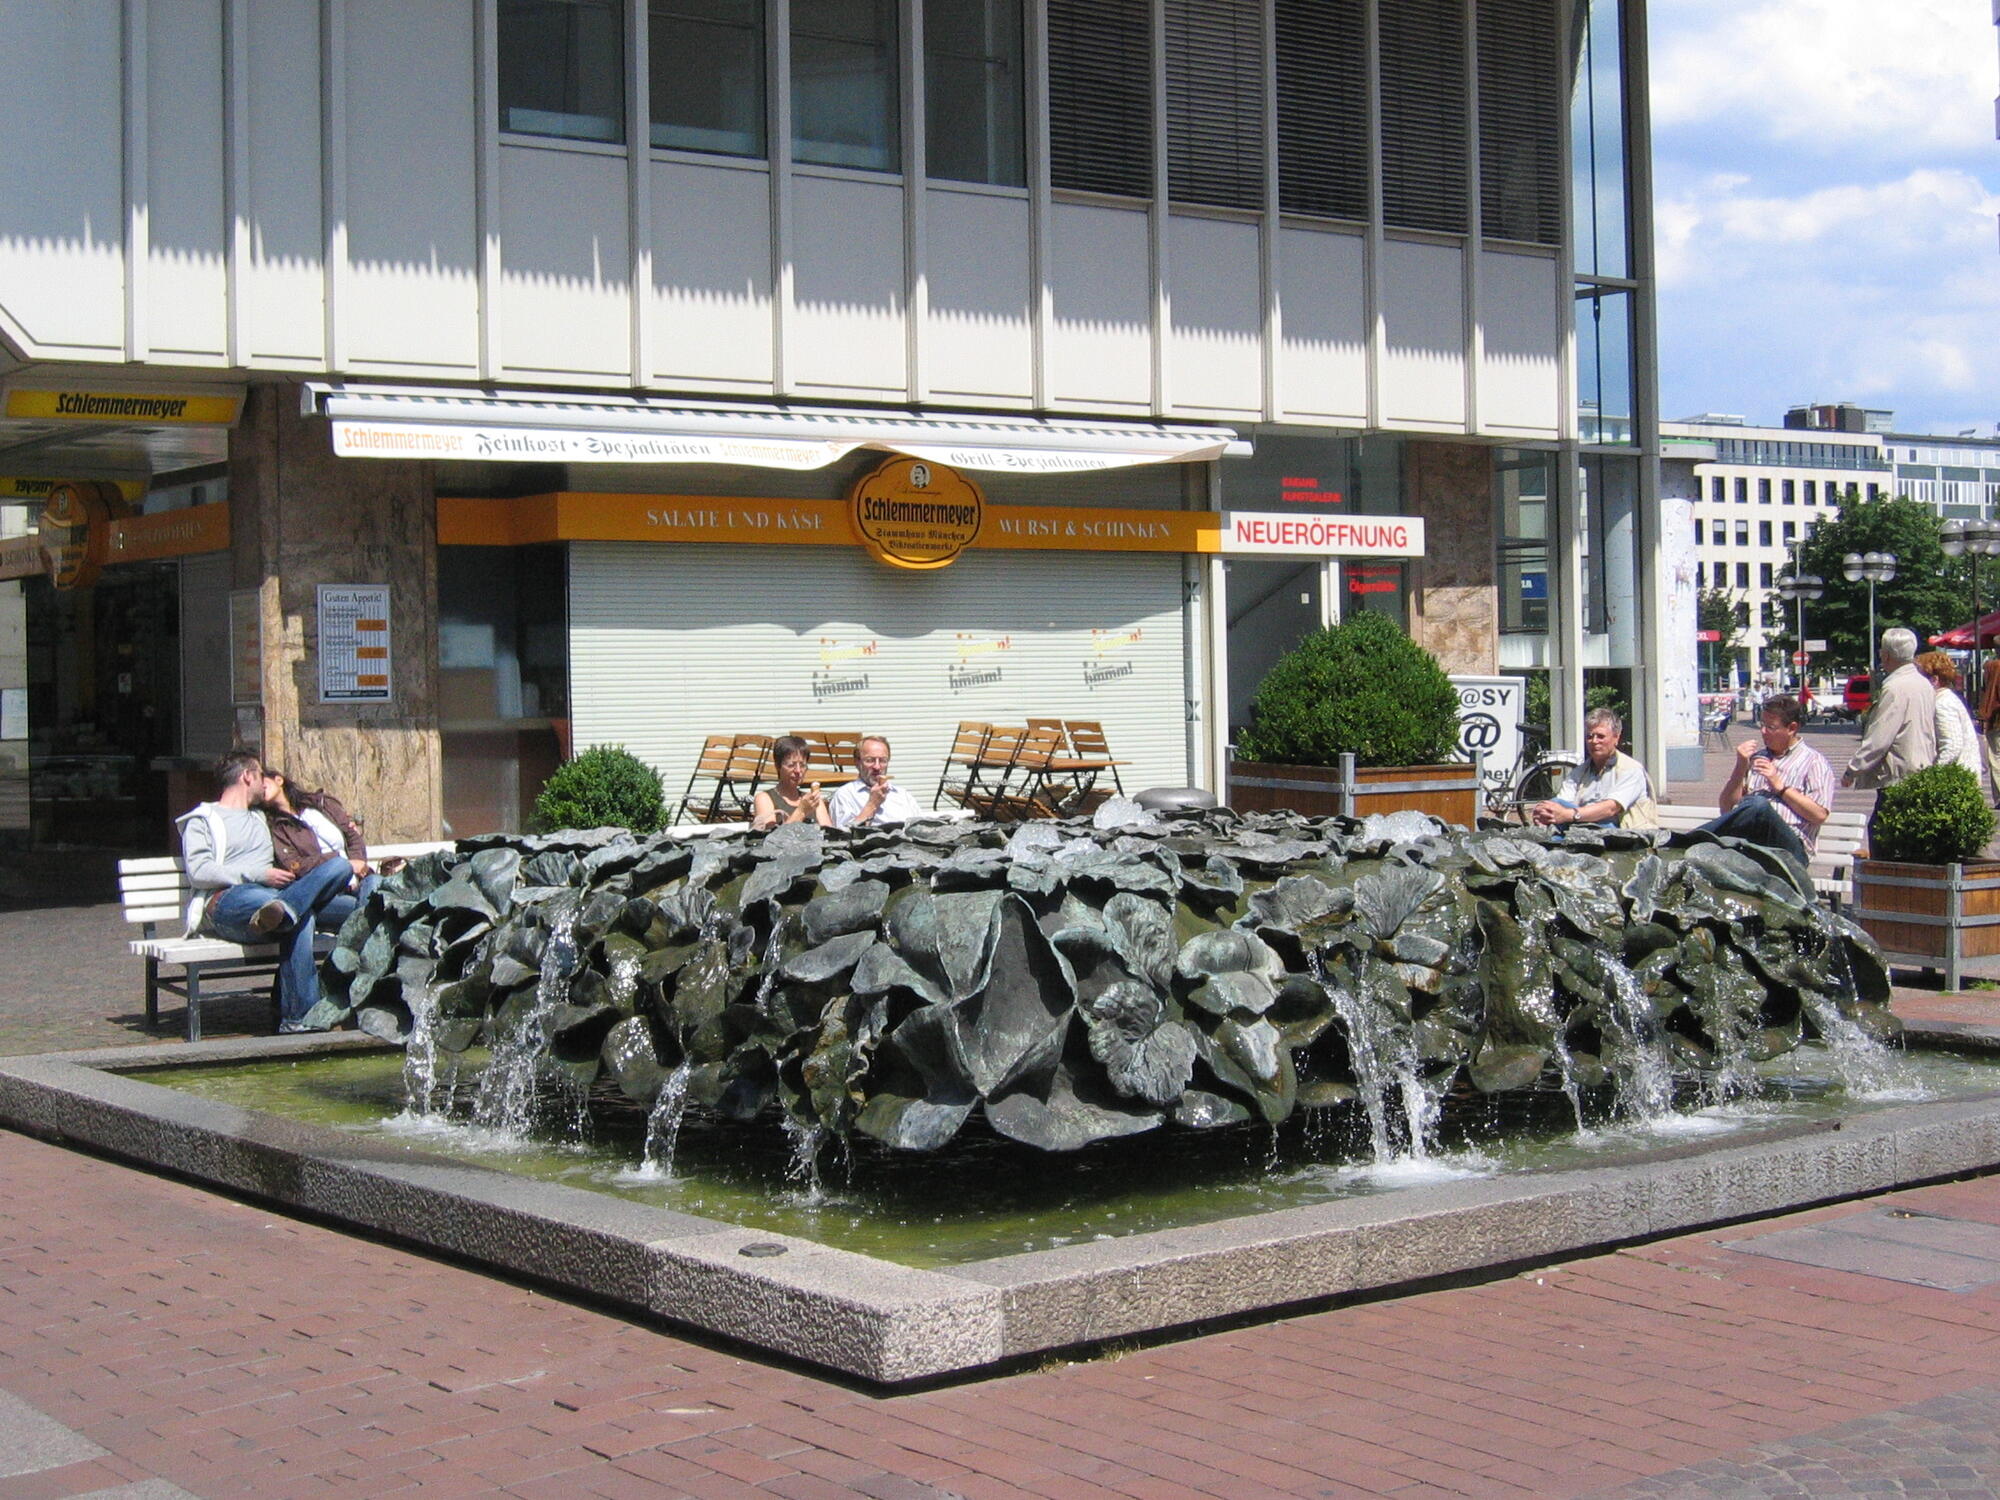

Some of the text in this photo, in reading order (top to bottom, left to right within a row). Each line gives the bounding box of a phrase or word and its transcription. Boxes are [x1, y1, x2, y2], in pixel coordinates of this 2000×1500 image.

[56, 393, 187, 418] Schlemmermeyer
[344, 427, 464, 451] Schlemmermeyer
[475, 433, 711, 458] Feinkost Spezialitäten
[719, 442, 820, 464] Schlemmermeyer
[647, 508, 823, 530] SALATE UND KÄSE
[864, 497, 976, 527] Schlemmermeyer
[999, 519, 1170, 539] WURST & SCHINKEN
[1237, 517, 1407, 548] NEUERÖFFNUNG
[325, 592, 382, 605] Guten Appetit!
[1460, 688, 1511, 708] @SY
